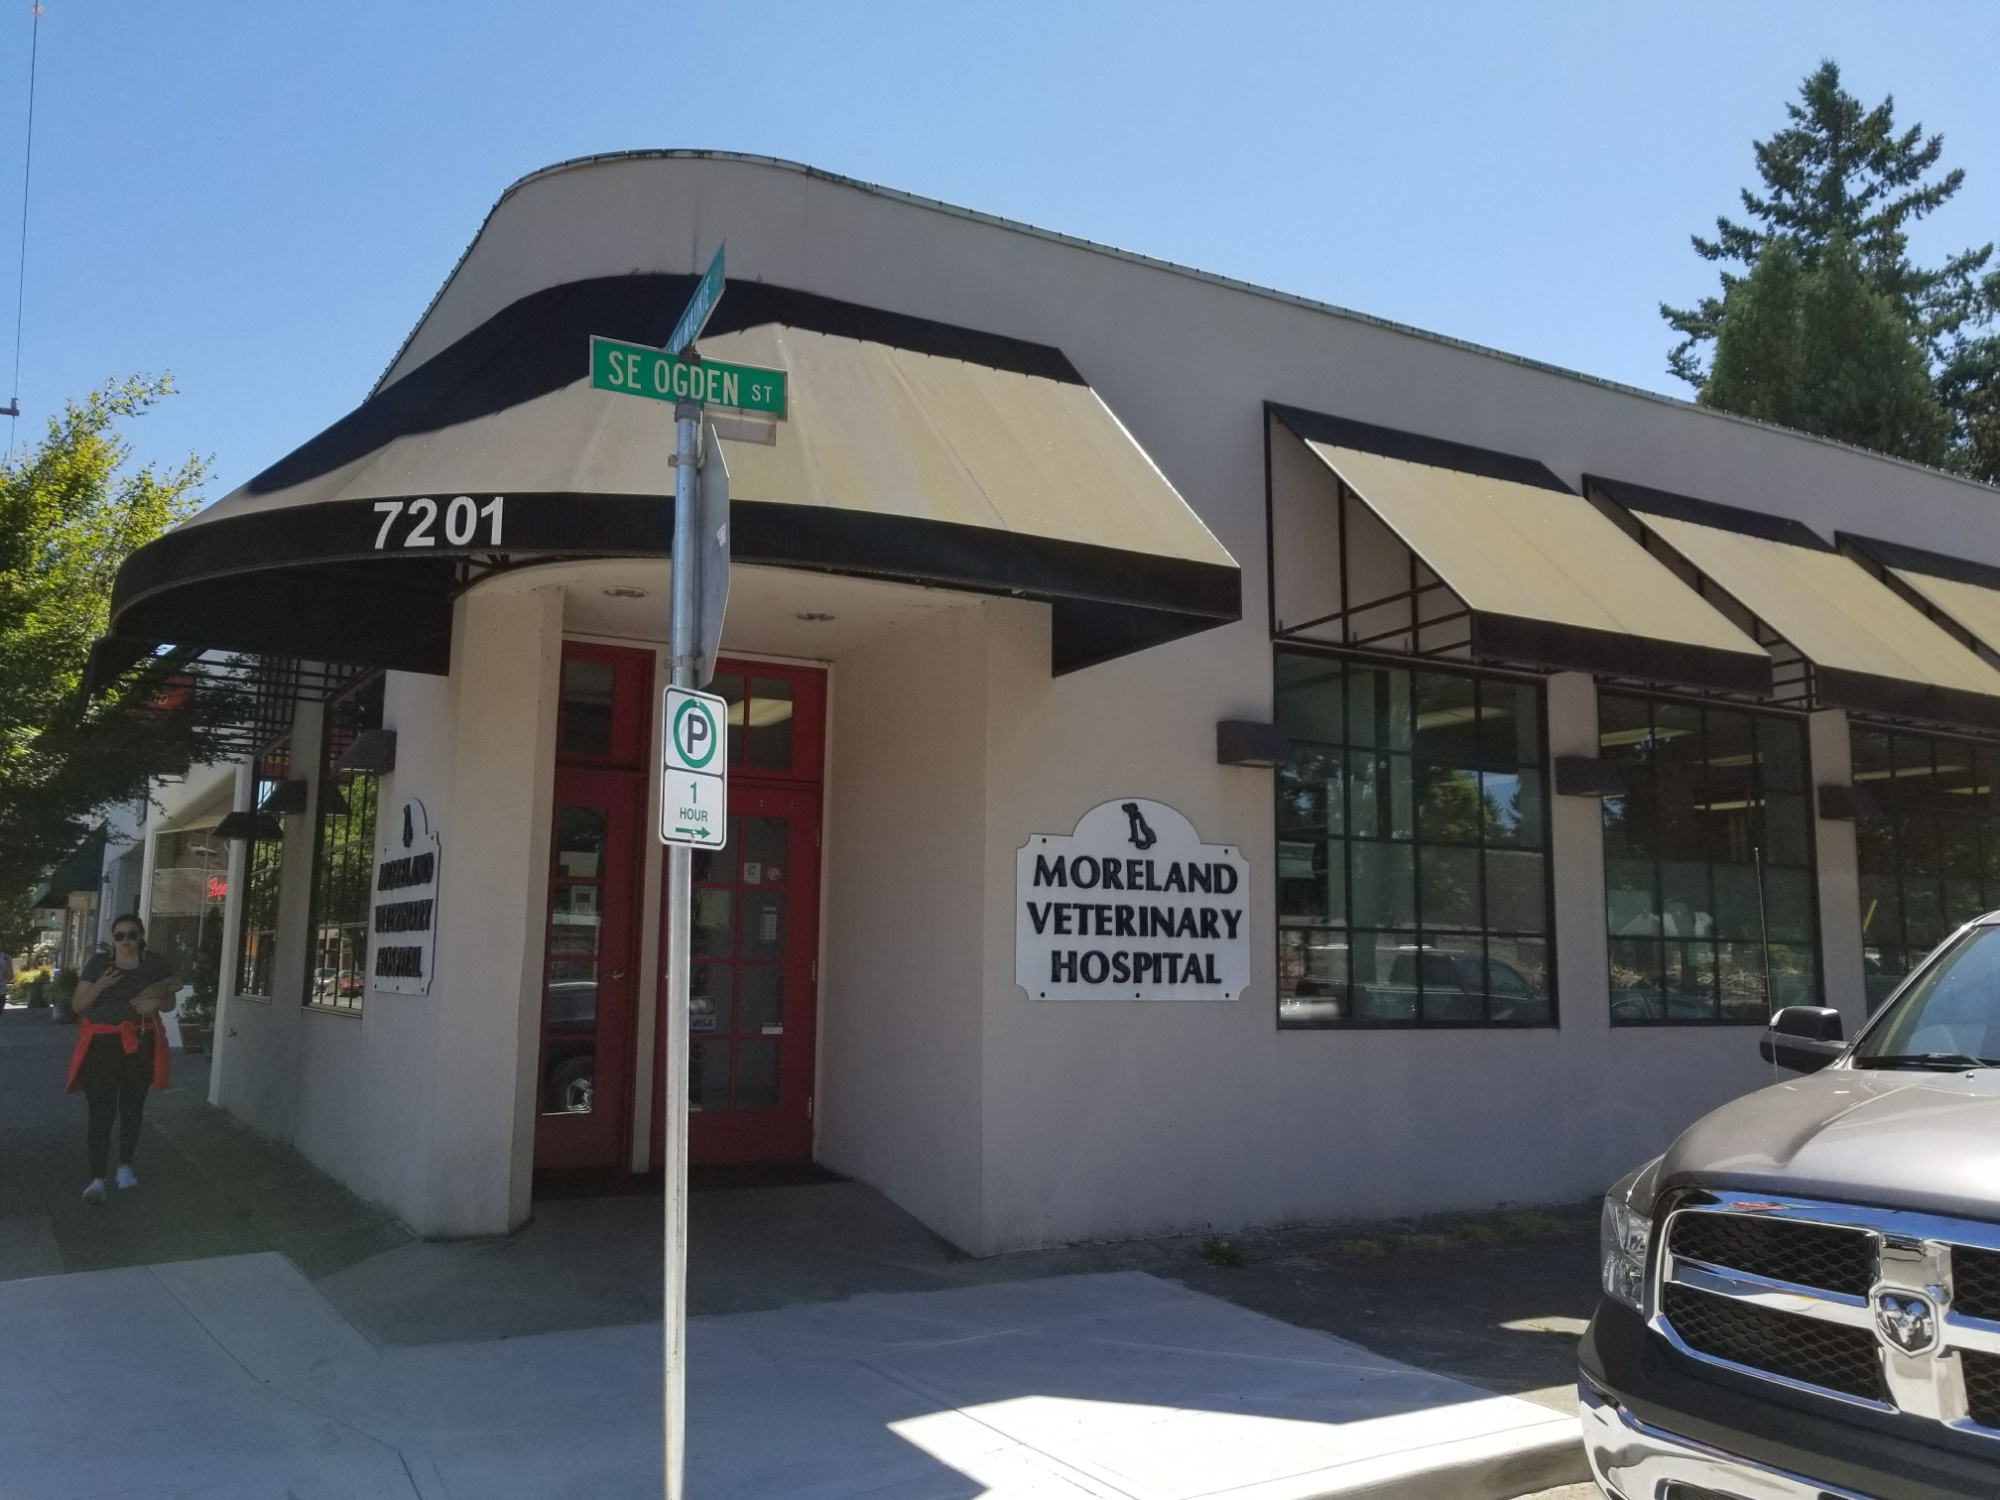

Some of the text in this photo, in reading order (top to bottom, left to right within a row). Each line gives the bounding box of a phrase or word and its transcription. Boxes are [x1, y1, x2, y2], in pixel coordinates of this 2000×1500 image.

[608, 351, 772, 406] SE OGDEN ST
[373, 496, 504, 550] 7201
[687, 713, 708, 754] P
[690, 781, 697, 804] 1
[679, 807, 708, 822] HOUR
[1033, 854, 1238, 894] MORELAND
[1026, 901, 1243, 940] VETERINARY
[1051, 950, 1222, 985] HOSPITAL
[692, 1018, 713, 1028] VISA
